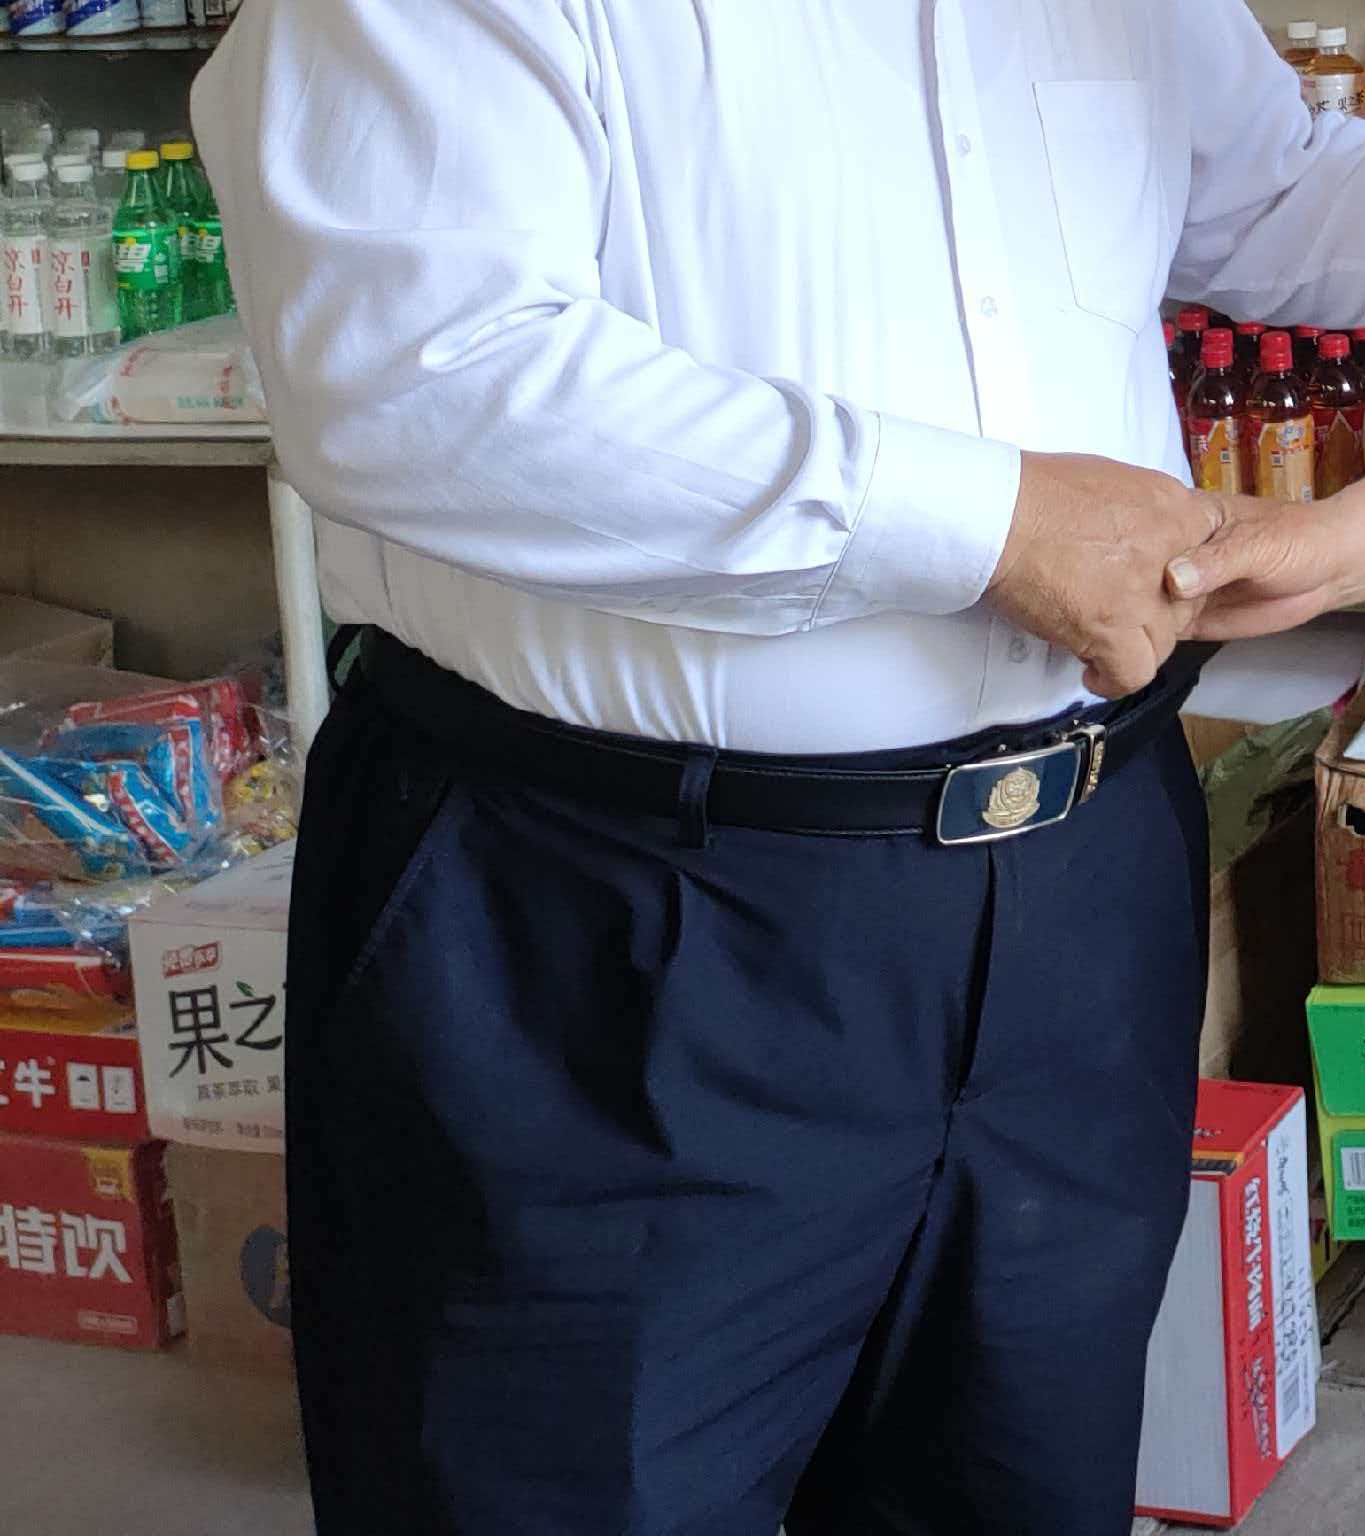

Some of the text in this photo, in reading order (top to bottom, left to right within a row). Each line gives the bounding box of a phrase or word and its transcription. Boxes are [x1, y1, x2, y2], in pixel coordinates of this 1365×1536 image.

[169, 983, 286, 1078] 果之
[0, 1055, 55, 1110] 牛
[0, 1203, 134, 1284] 特饮
